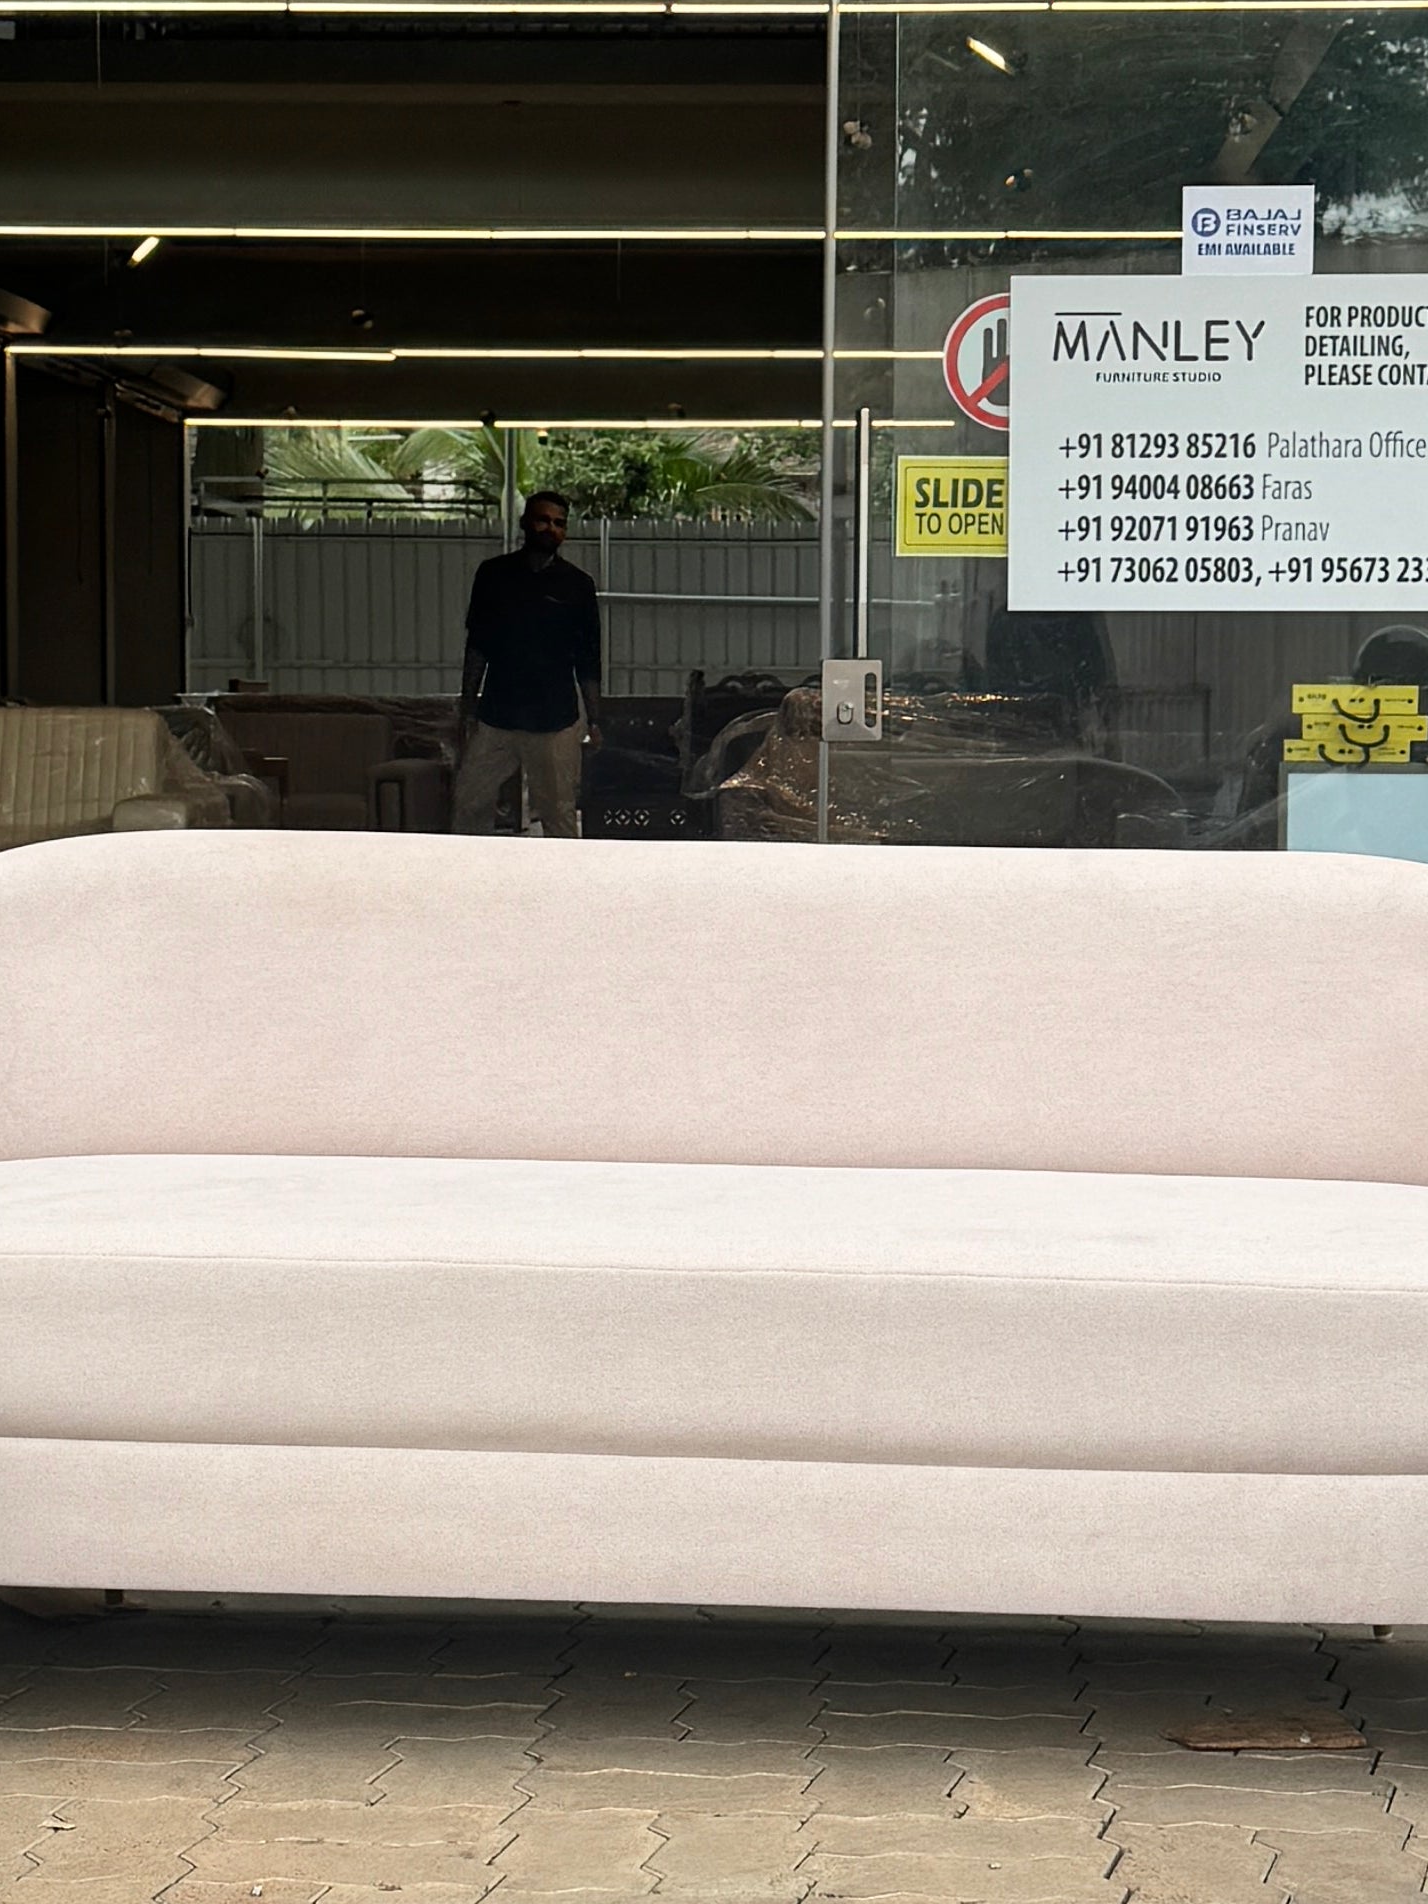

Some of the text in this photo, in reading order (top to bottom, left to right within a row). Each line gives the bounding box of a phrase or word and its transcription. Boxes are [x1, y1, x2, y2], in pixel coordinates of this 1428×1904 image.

[1227, 209, 1301, 220] BAJAJ
[1226, 224, 1301, 236] FINSERV
[1198, 243, 1294, 255] EMI AVAILABLE
[1306, 306, 1341, 327] FOR
[1053, 320, 1264, 361] MANLEY
[1306, 335, 1409, 361] DETAILING,
[1096, 372, 1221, 382] FURNITURE STUDIO
[1305, 364, 1372, 385] PLEASE
[1059, 431, 1426, 458] +91 81293 85216 Palathara Office
[915, 478, 1005, 508] SLIDE
[1059, 474, 1312, 499] +91 94004 08663 Faras
[915, 513, 1003, 535] TO OPEN
[1058, 515, 1329, 541] +91 92071 91963 Pranav
[1058, 557, 1100, 582] +91
[1111, 557, 1178, 582] 73062
[1186, 557, 1261, 586] 05803,
[1269, 557, 1312, 582] +91
[1322, 557, 1389, 582] 95673
